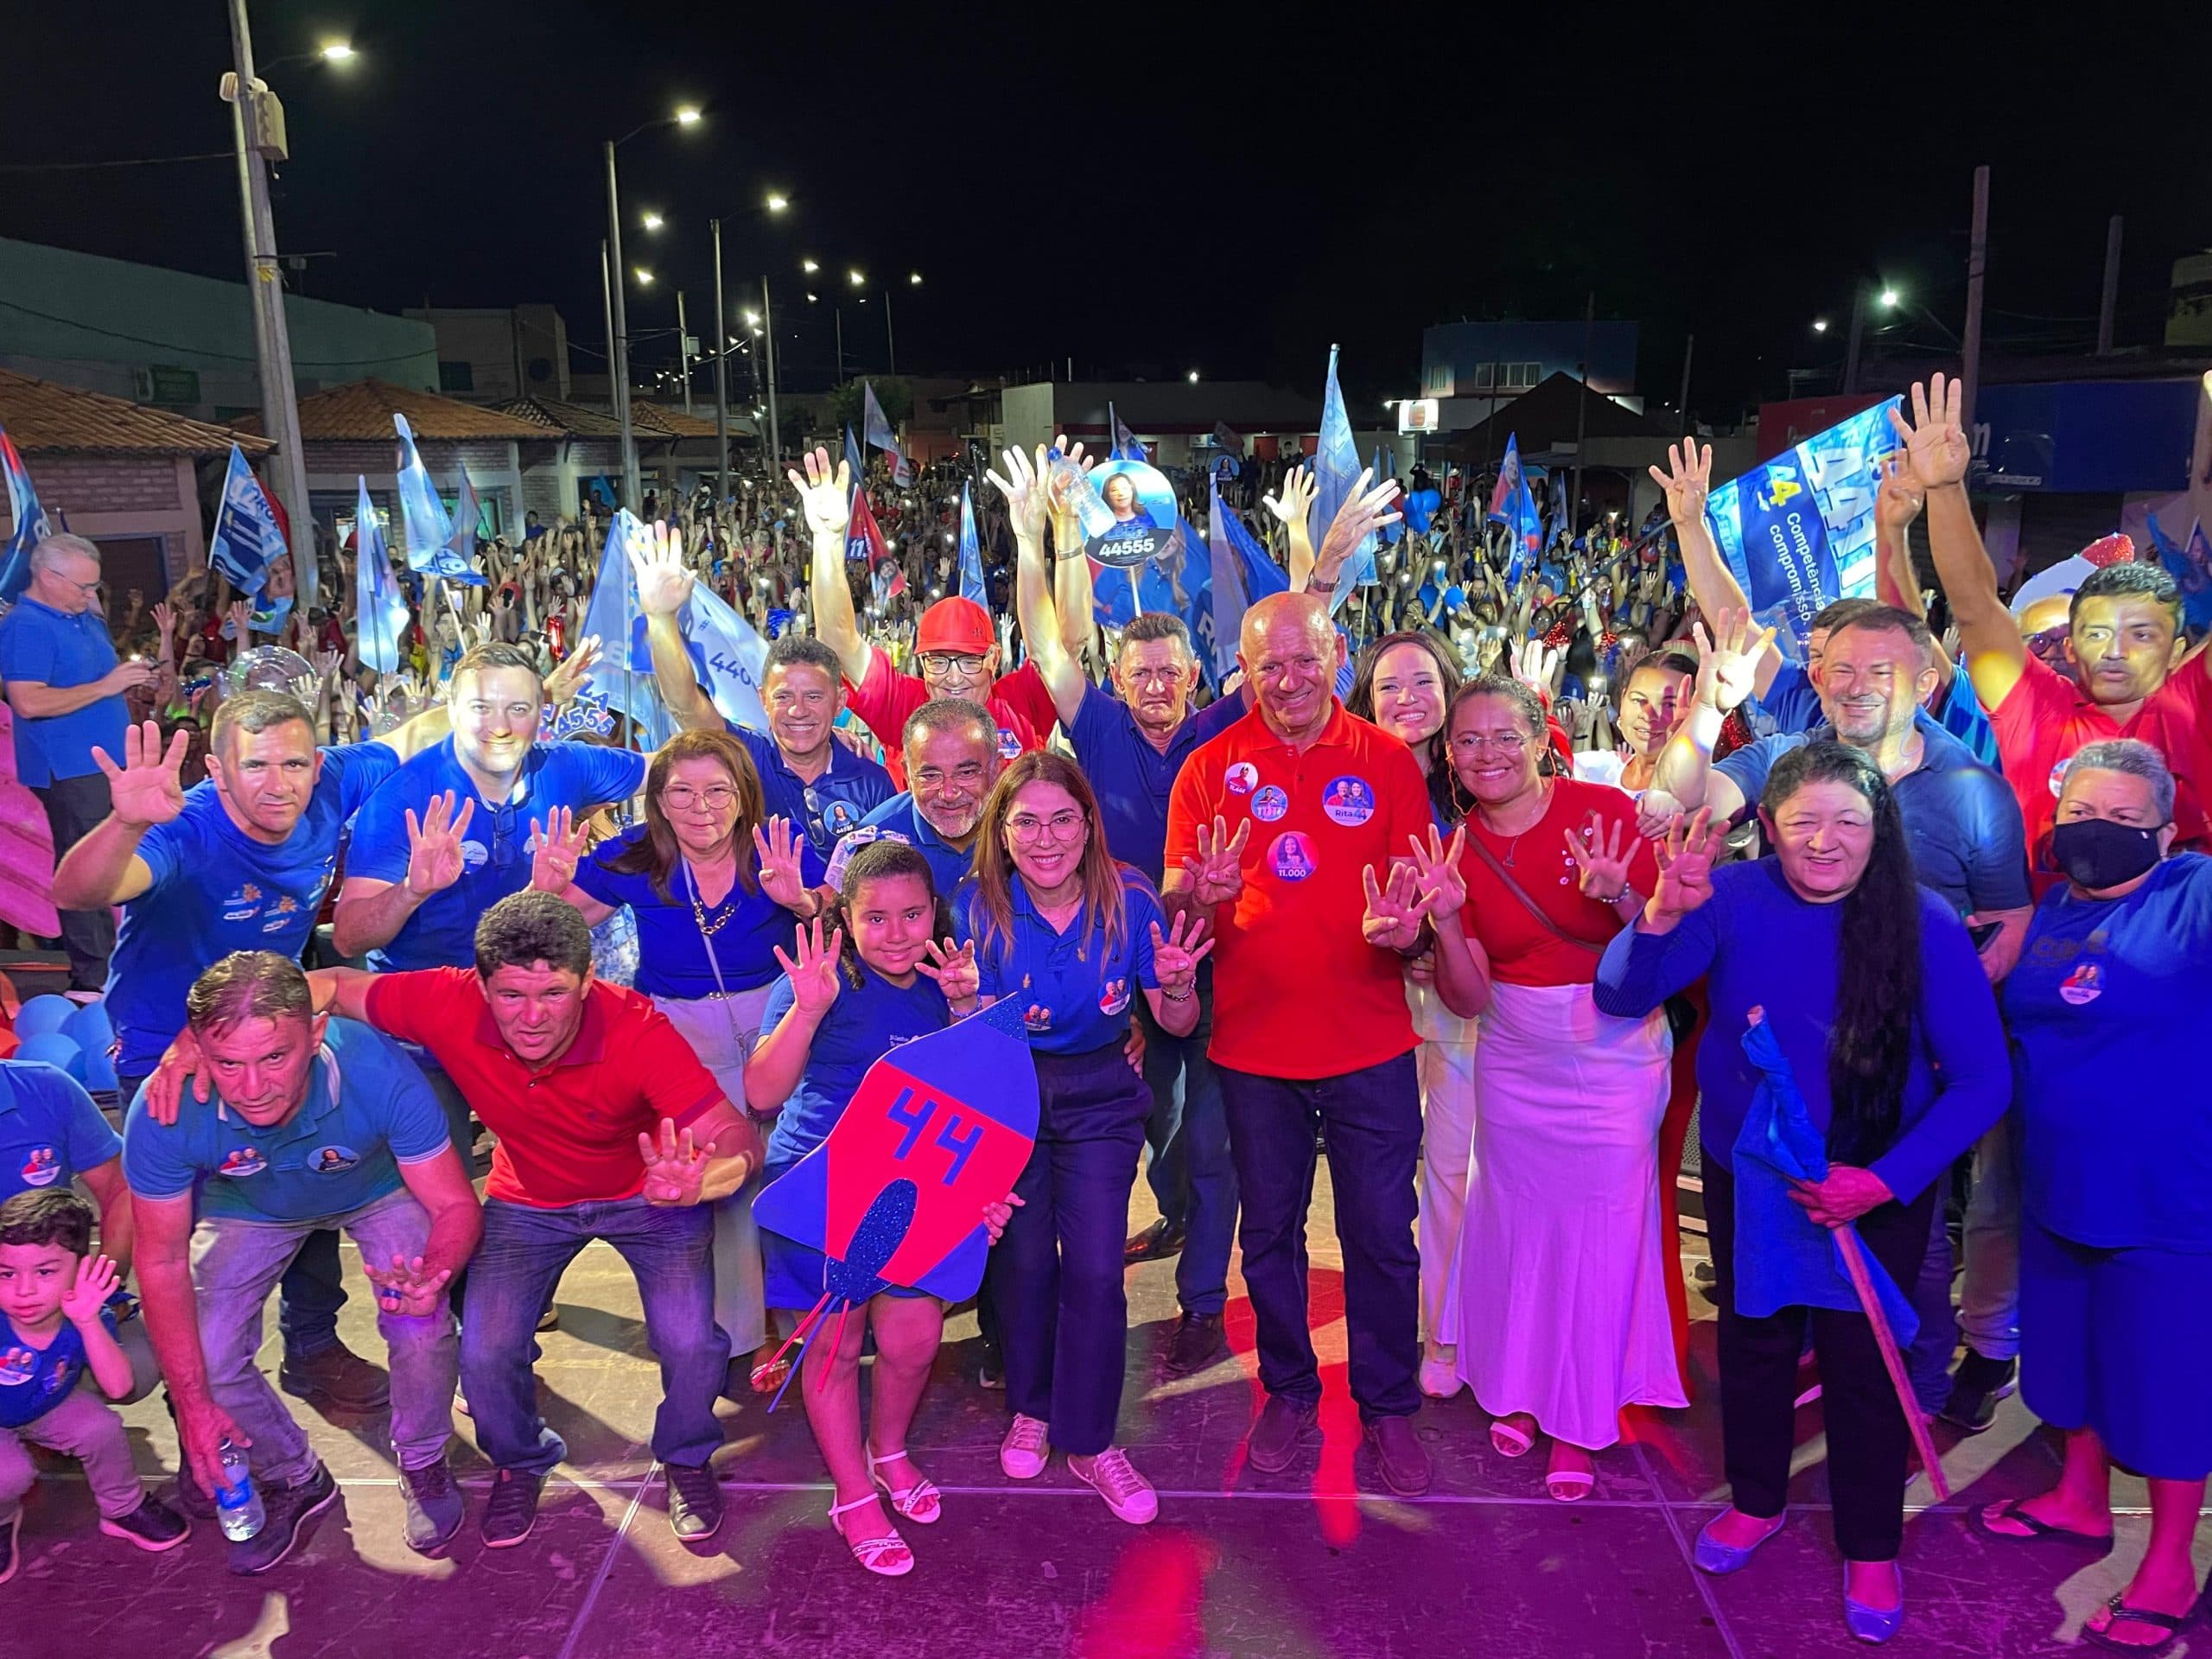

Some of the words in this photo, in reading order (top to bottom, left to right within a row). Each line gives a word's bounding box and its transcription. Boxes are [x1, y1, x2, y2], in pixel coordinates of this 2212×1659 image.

[1099, 537, 1155, 557] 44555
[1786, 512, 1826, 611] Competência
[709, 652, 759, 693] 440
[1335, 809, 1353, 817] Rita
[887, 1085, 986, 1187] 44
